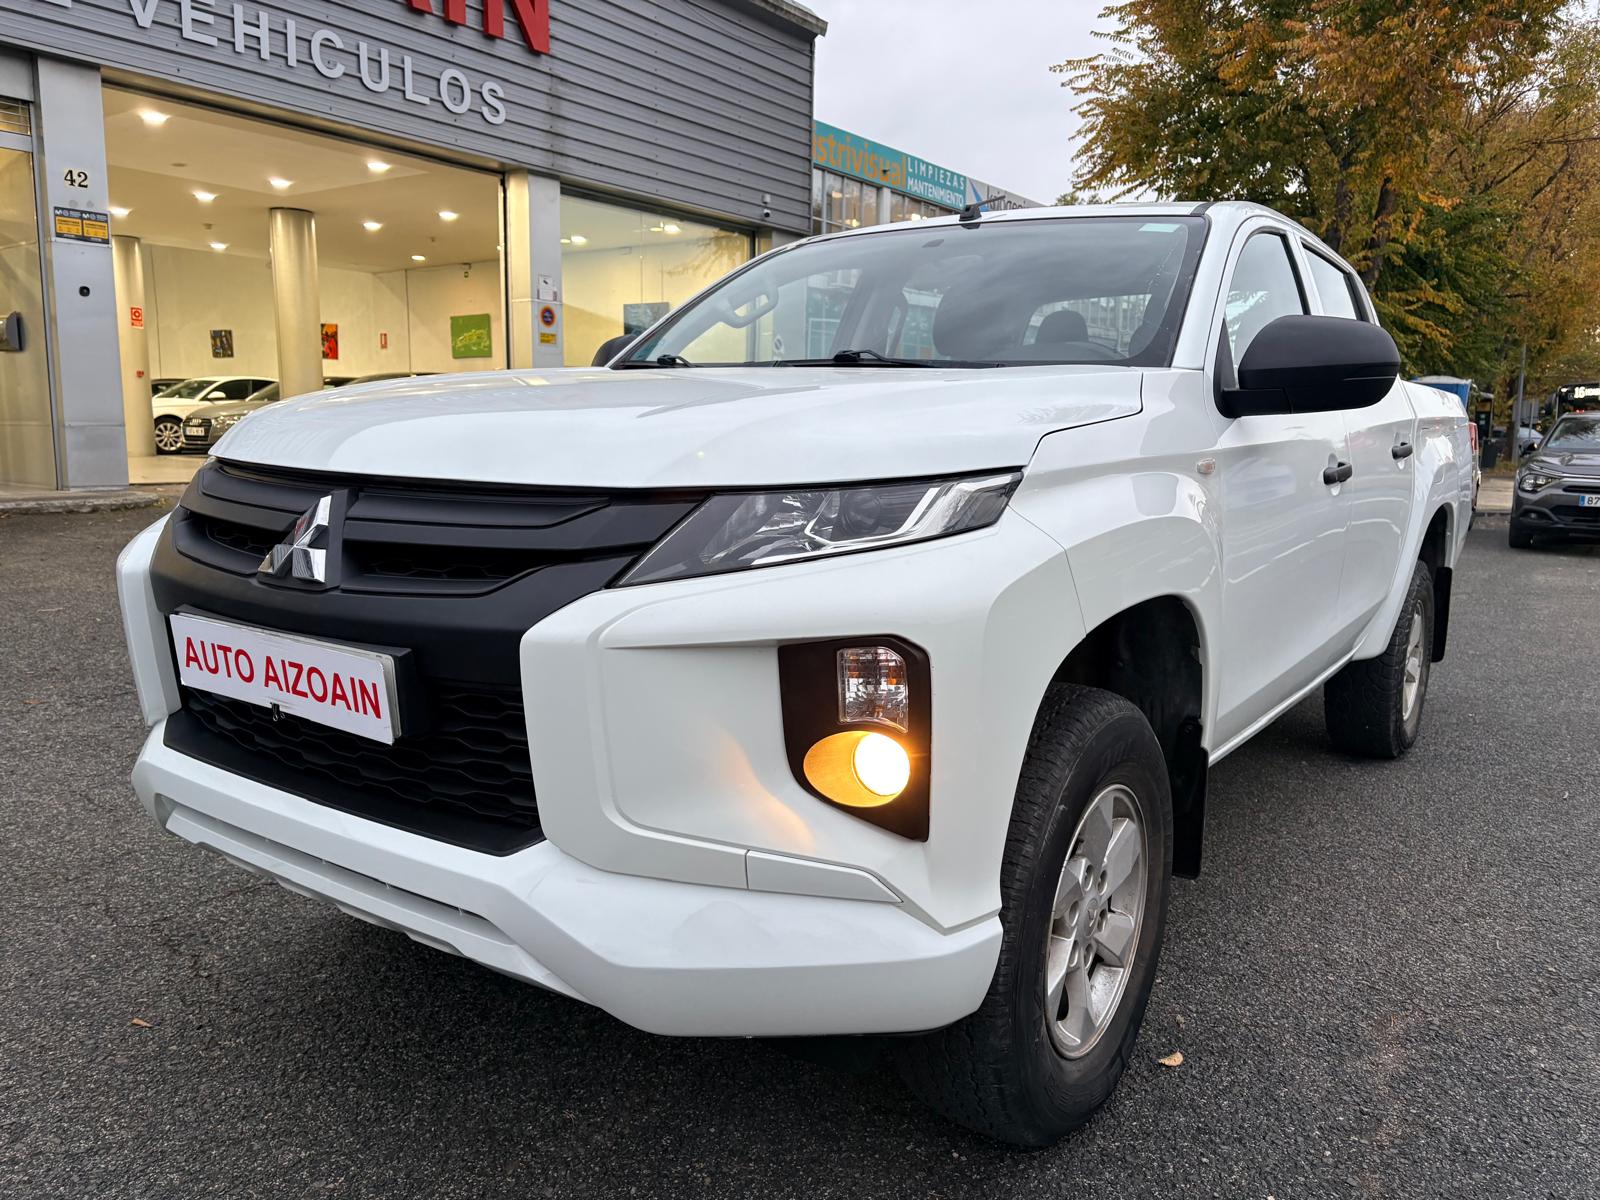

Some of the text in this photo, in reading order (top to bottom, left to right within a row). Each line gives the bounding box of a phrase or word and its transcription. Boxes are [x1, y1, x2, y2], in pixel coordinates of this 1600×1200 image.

[129, 0, 507, 125] VEHICULOS
[64, 169, 89, 188] 42
[907, 156, 965, 190] LIMPIEZAS
[907, 176, 964, 207] MANTENIMIENTO
[1574, 386, 1586, 399] 16
[185, 636, 382, 720] AUTO AIZOAIN
